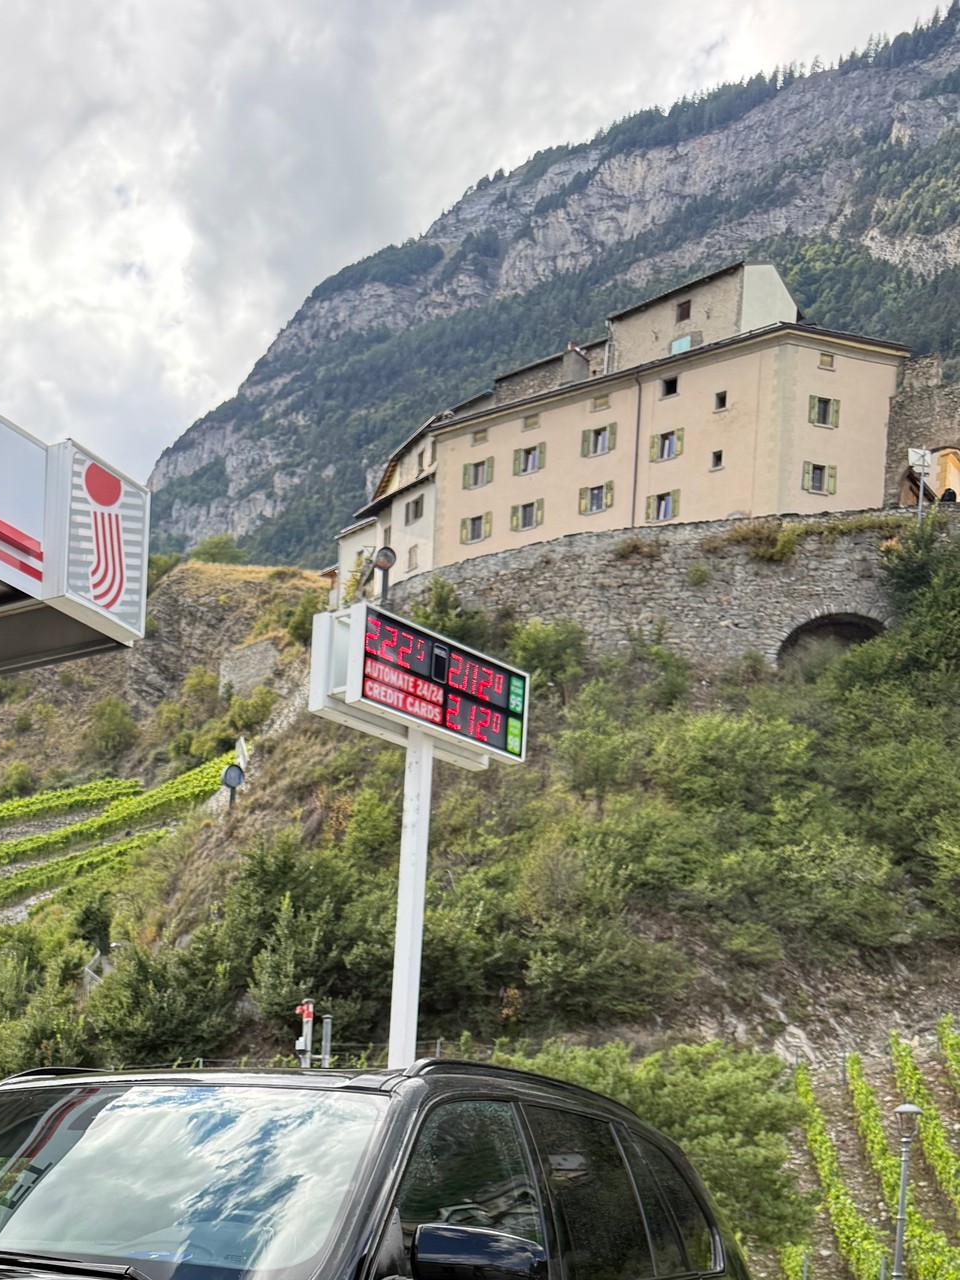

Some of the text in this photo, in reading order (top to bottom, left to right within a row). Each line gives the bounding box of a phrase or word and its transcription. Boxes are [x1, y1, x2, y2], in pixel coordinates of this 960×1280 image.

[365, 660, 443, 705] AUTOMATE 24/24
[365, 681, 440, 722] CREDIT CARDS
[509, 694, 522, 712] 95
